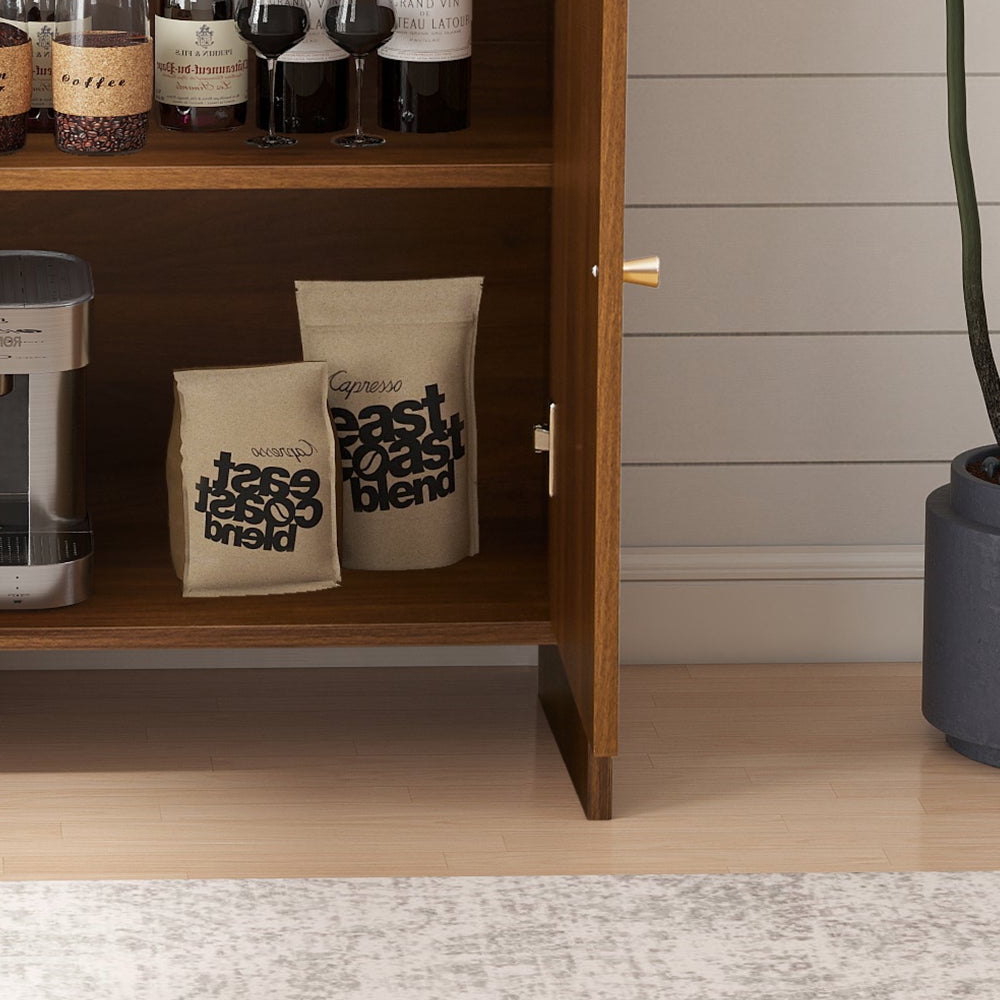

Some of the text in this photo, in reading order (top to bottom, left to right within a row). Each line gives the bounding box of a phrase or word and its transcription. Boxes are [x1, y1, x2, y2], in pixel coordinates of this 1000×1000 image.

[61, 73, 127, 90] Coffee
[329, 369, 403, 401] Capresso
[330, 383, 446, 448] east
[351, 459, 456, 513] blend
